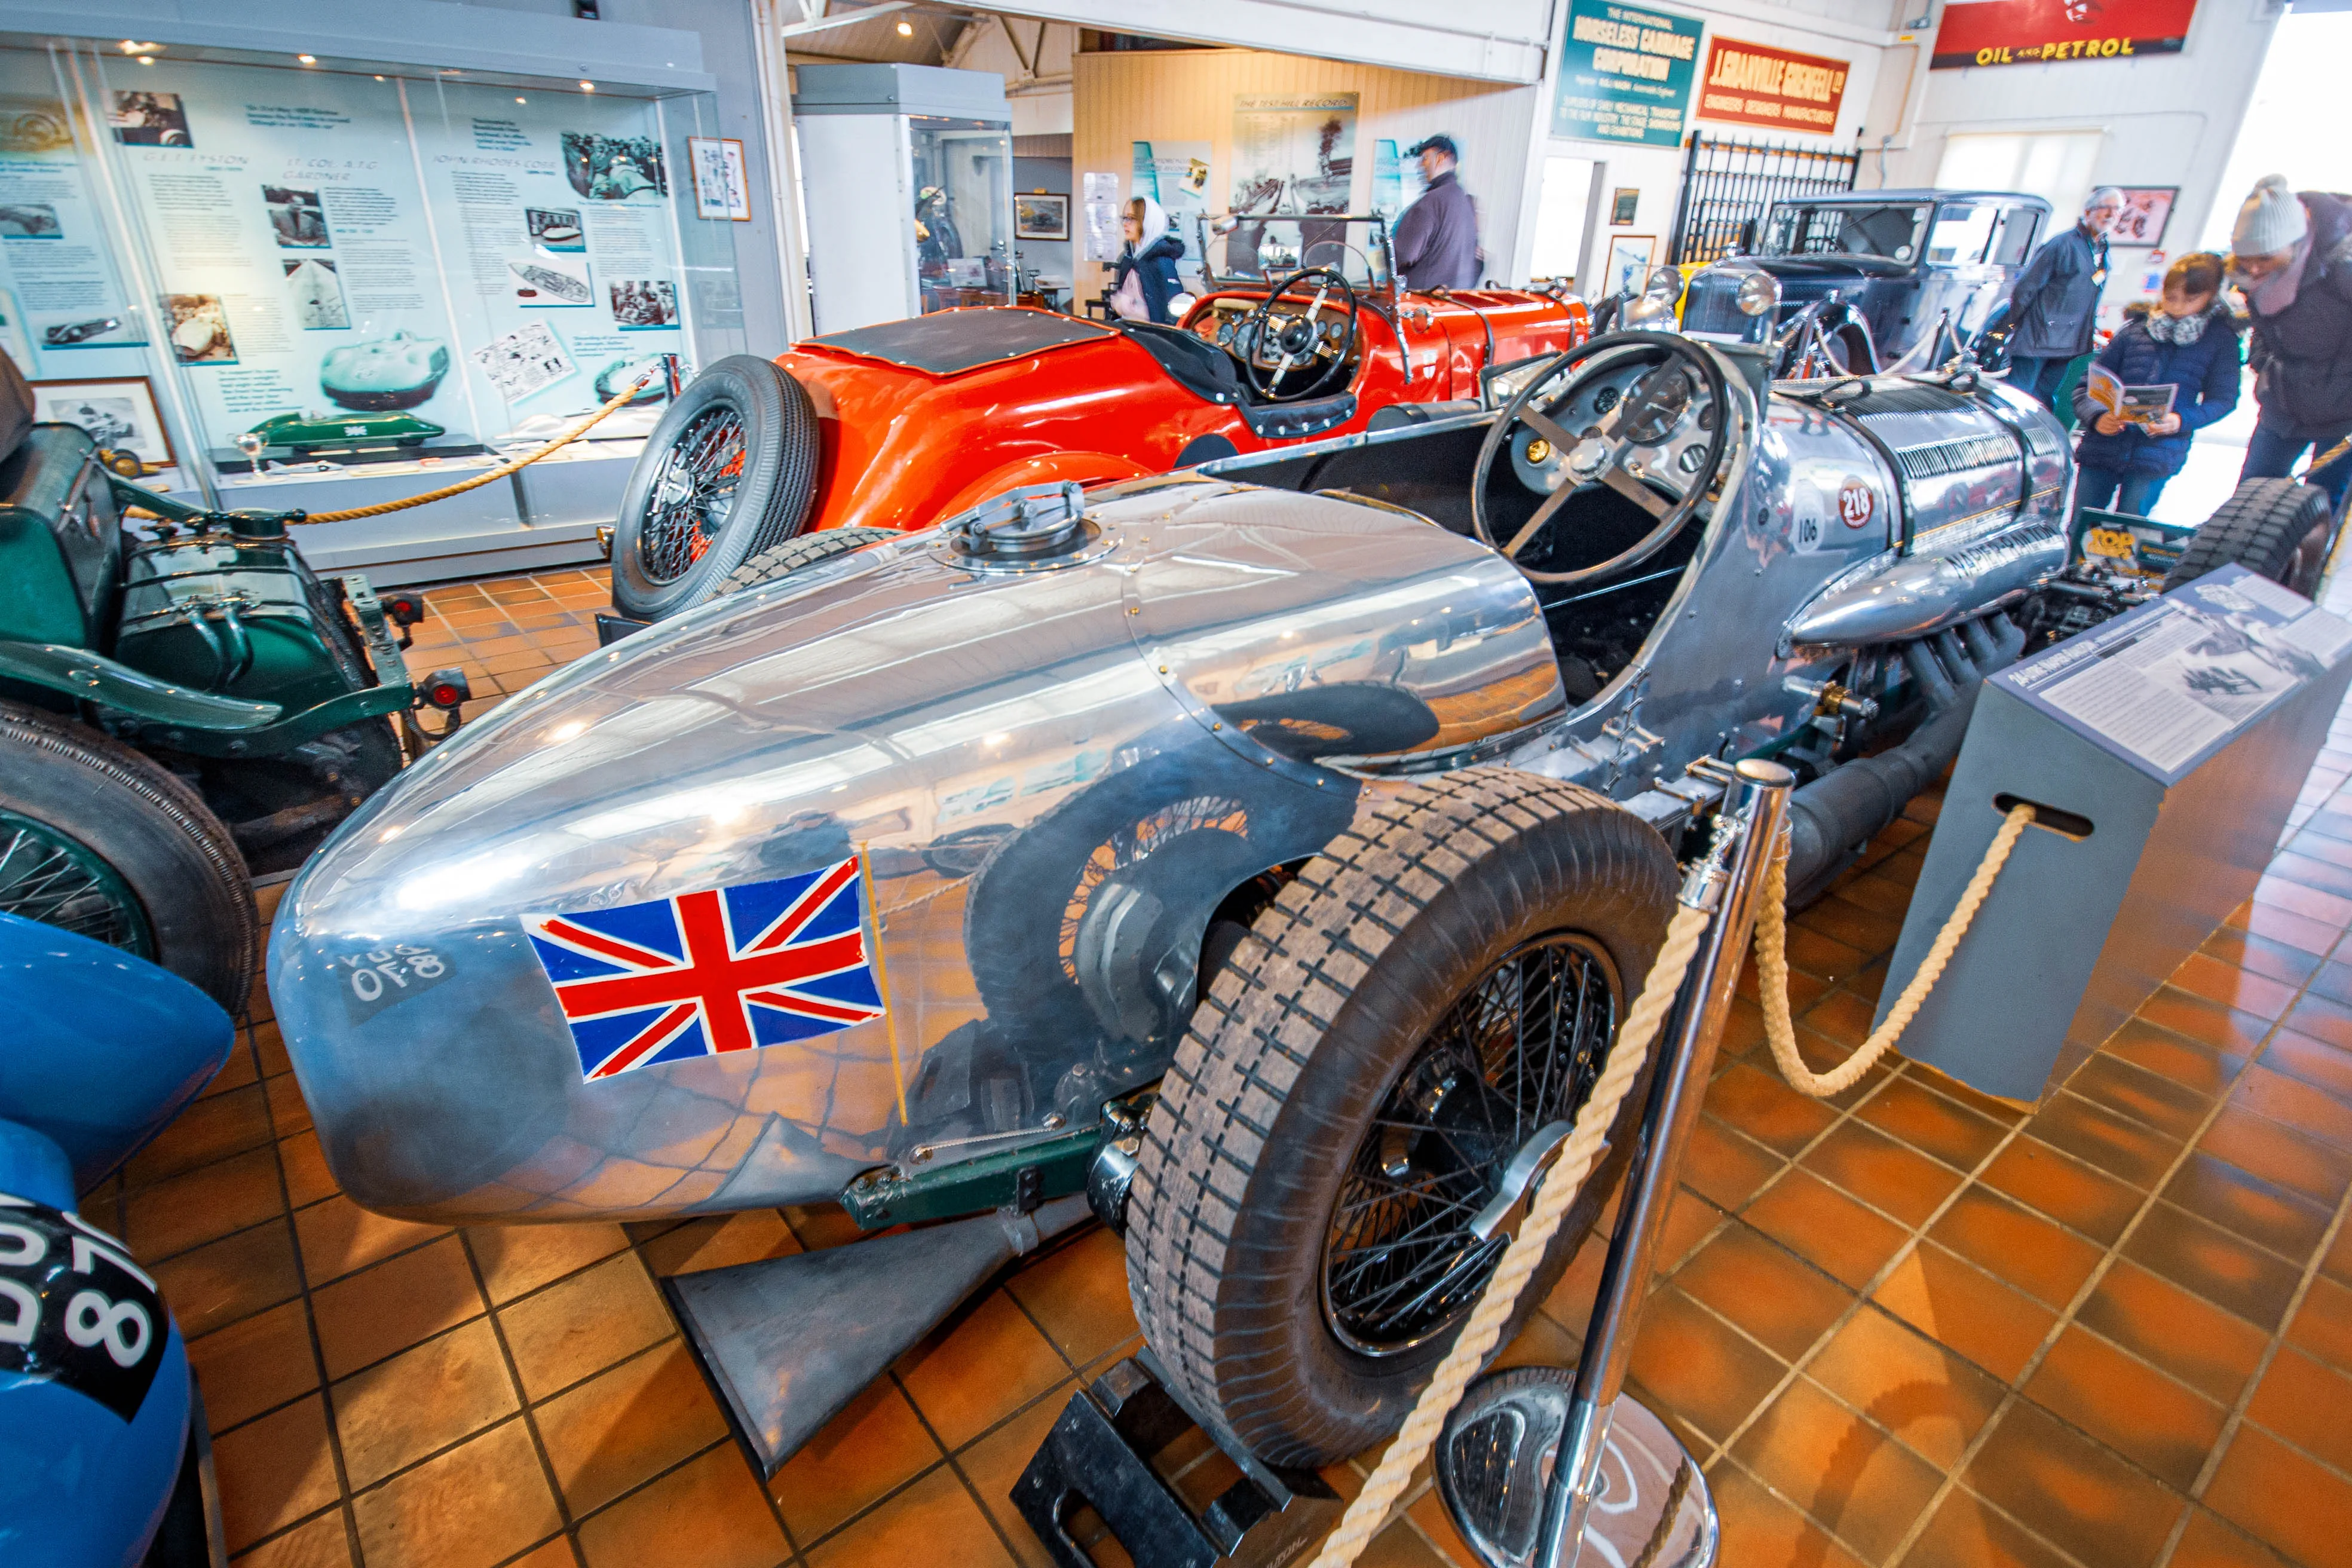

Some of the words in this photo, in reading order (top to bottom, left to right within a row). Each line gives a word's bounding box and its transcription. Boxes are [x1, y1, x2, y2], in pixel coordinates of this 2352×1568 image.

[1607, 7, 1622, 20] THE
[1623, 10, 1673, 30] INTERNATIONAL
[1573, 15, 1640, 50] HORSELESS
[1639, 28, 1695, 61] CARRIAGE
[1976, 47, 2013, 66] OIL
[2017, 48, 2041, 59] AND
[2041, 37, 2134, 60] PETROL
[1301, 98, 1348, 108] RECORD
[1843, 488, 1870, 517] 218
